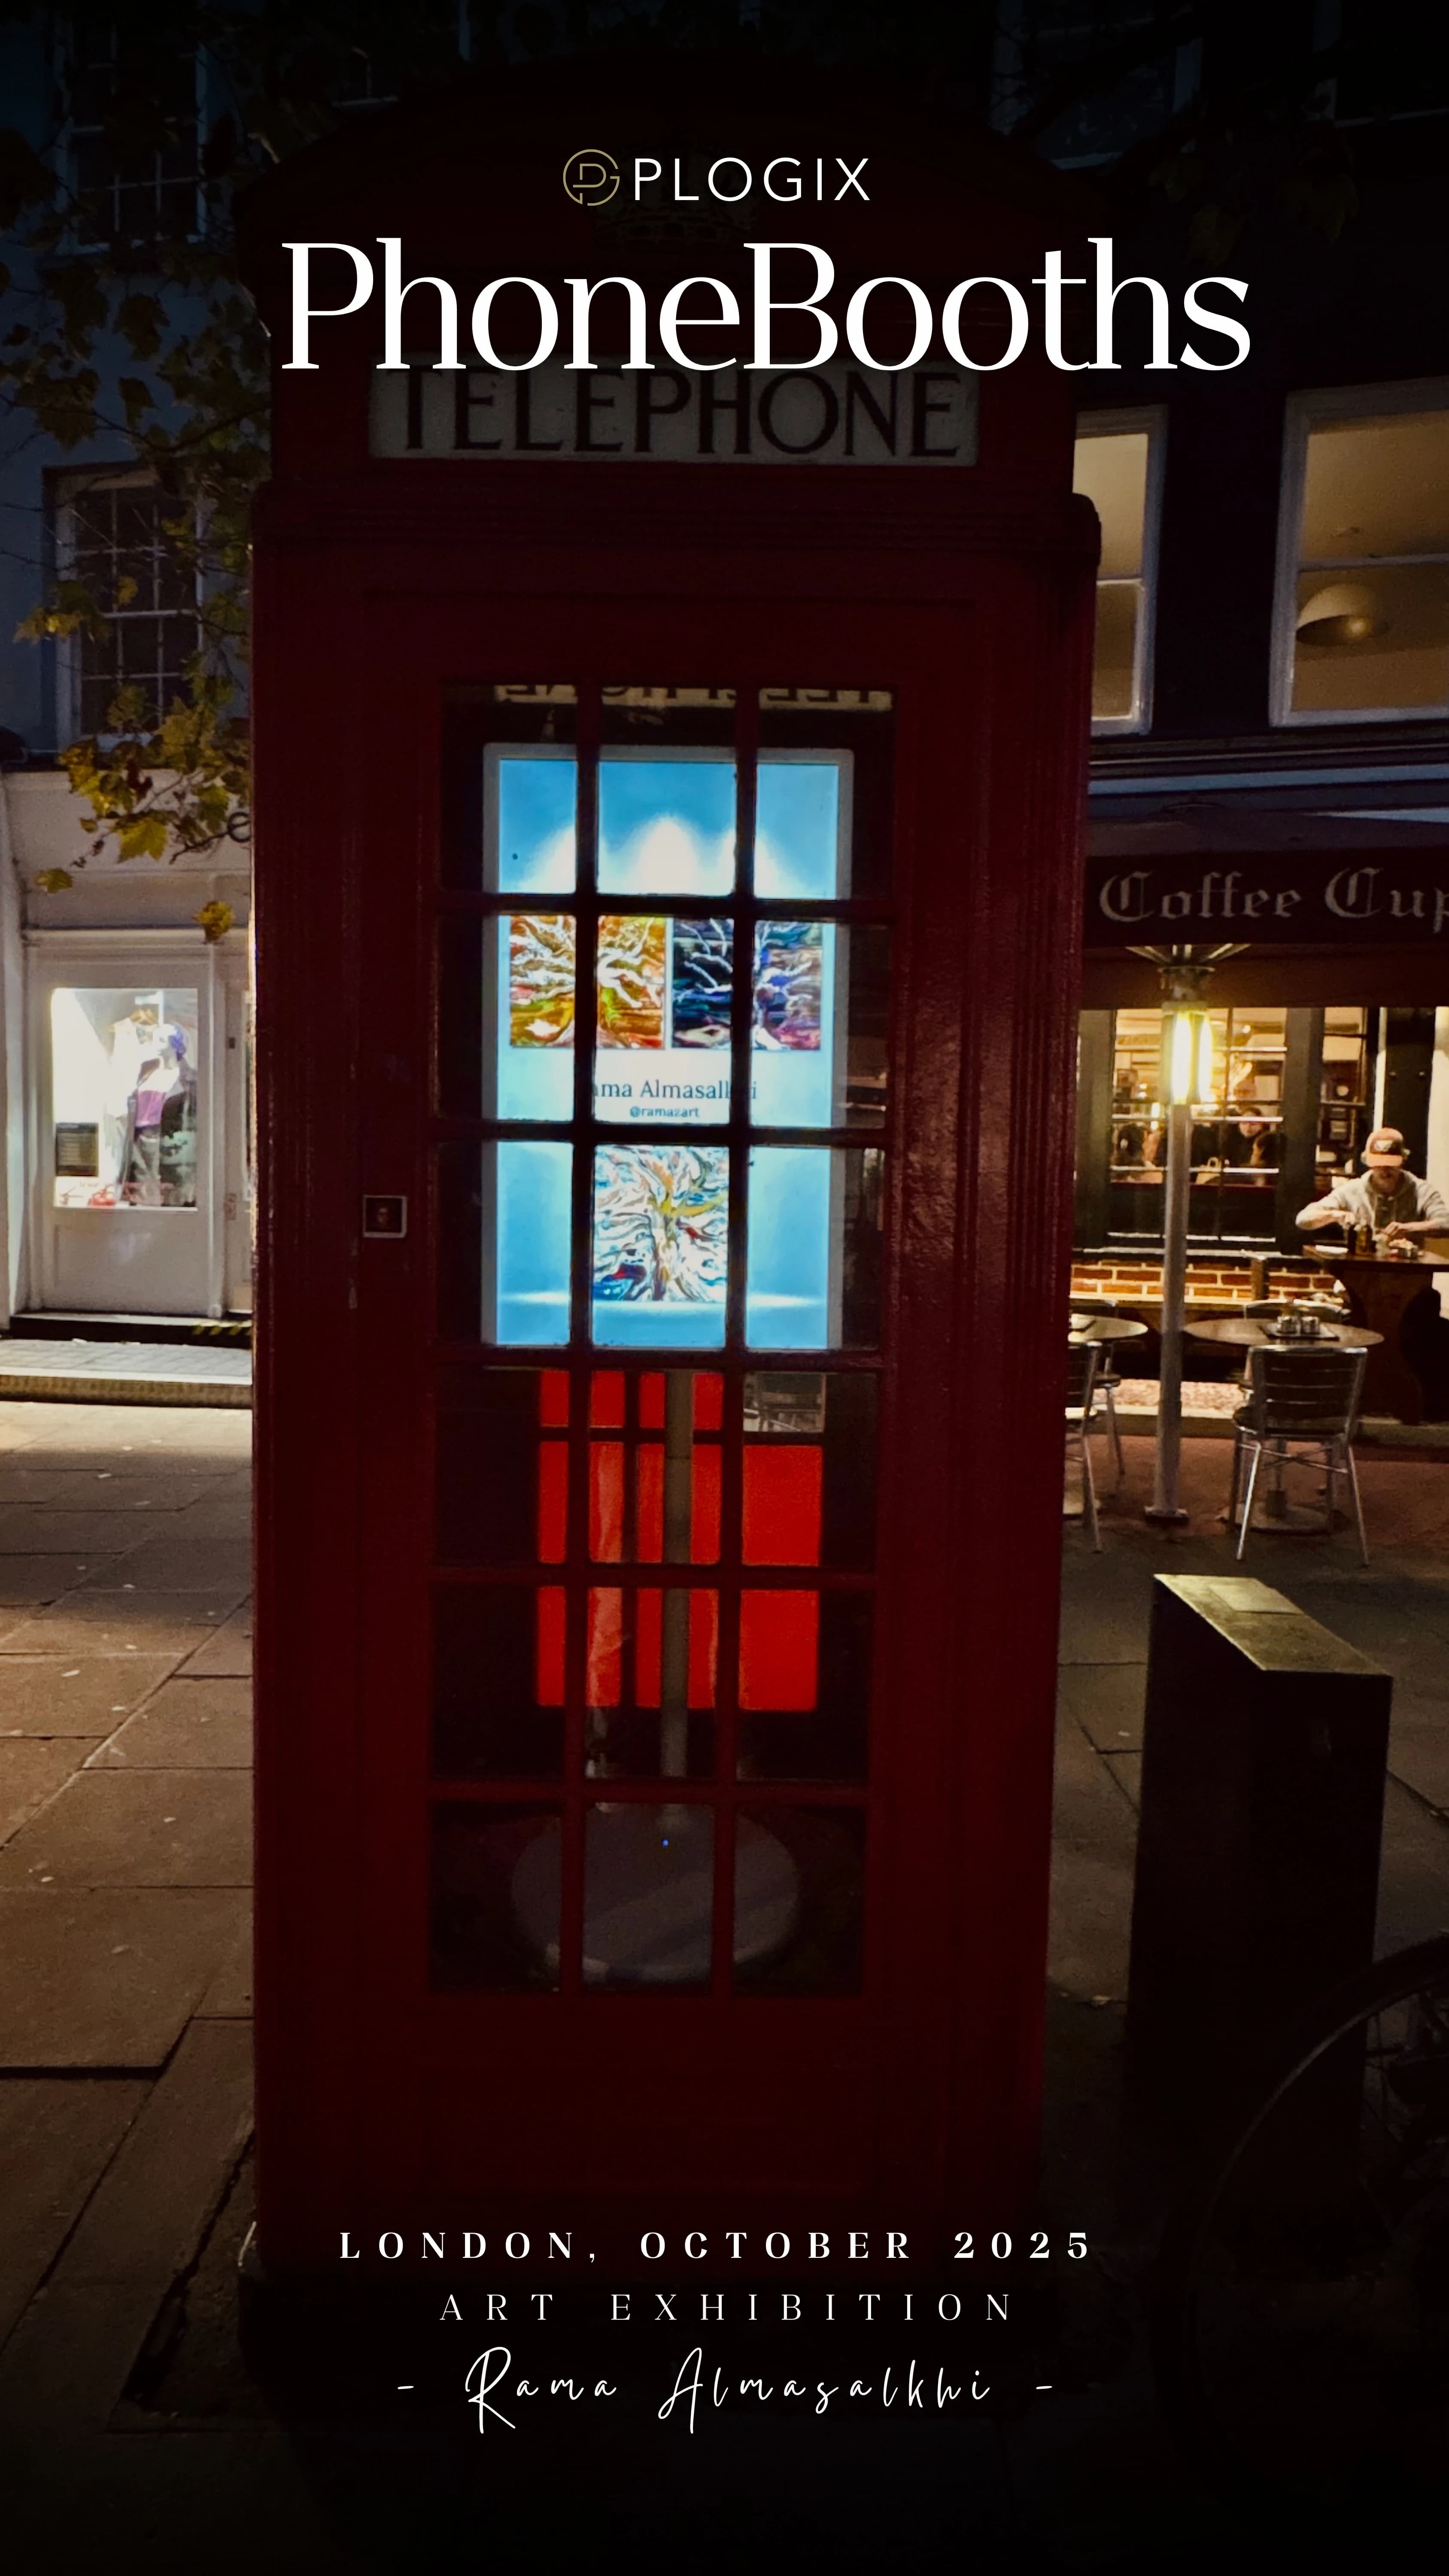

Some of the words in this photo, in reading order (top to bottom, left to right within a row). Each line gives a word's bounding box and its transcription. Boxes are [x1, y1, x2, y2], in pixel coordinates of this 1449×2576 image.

[386, 365, 961, 458] TELEPHONE
[1098, 869, 1303, 923] Coffee
[1324, 866, 1449, 934] Cup
[630, 1106, 700, 1118] @ramazart
